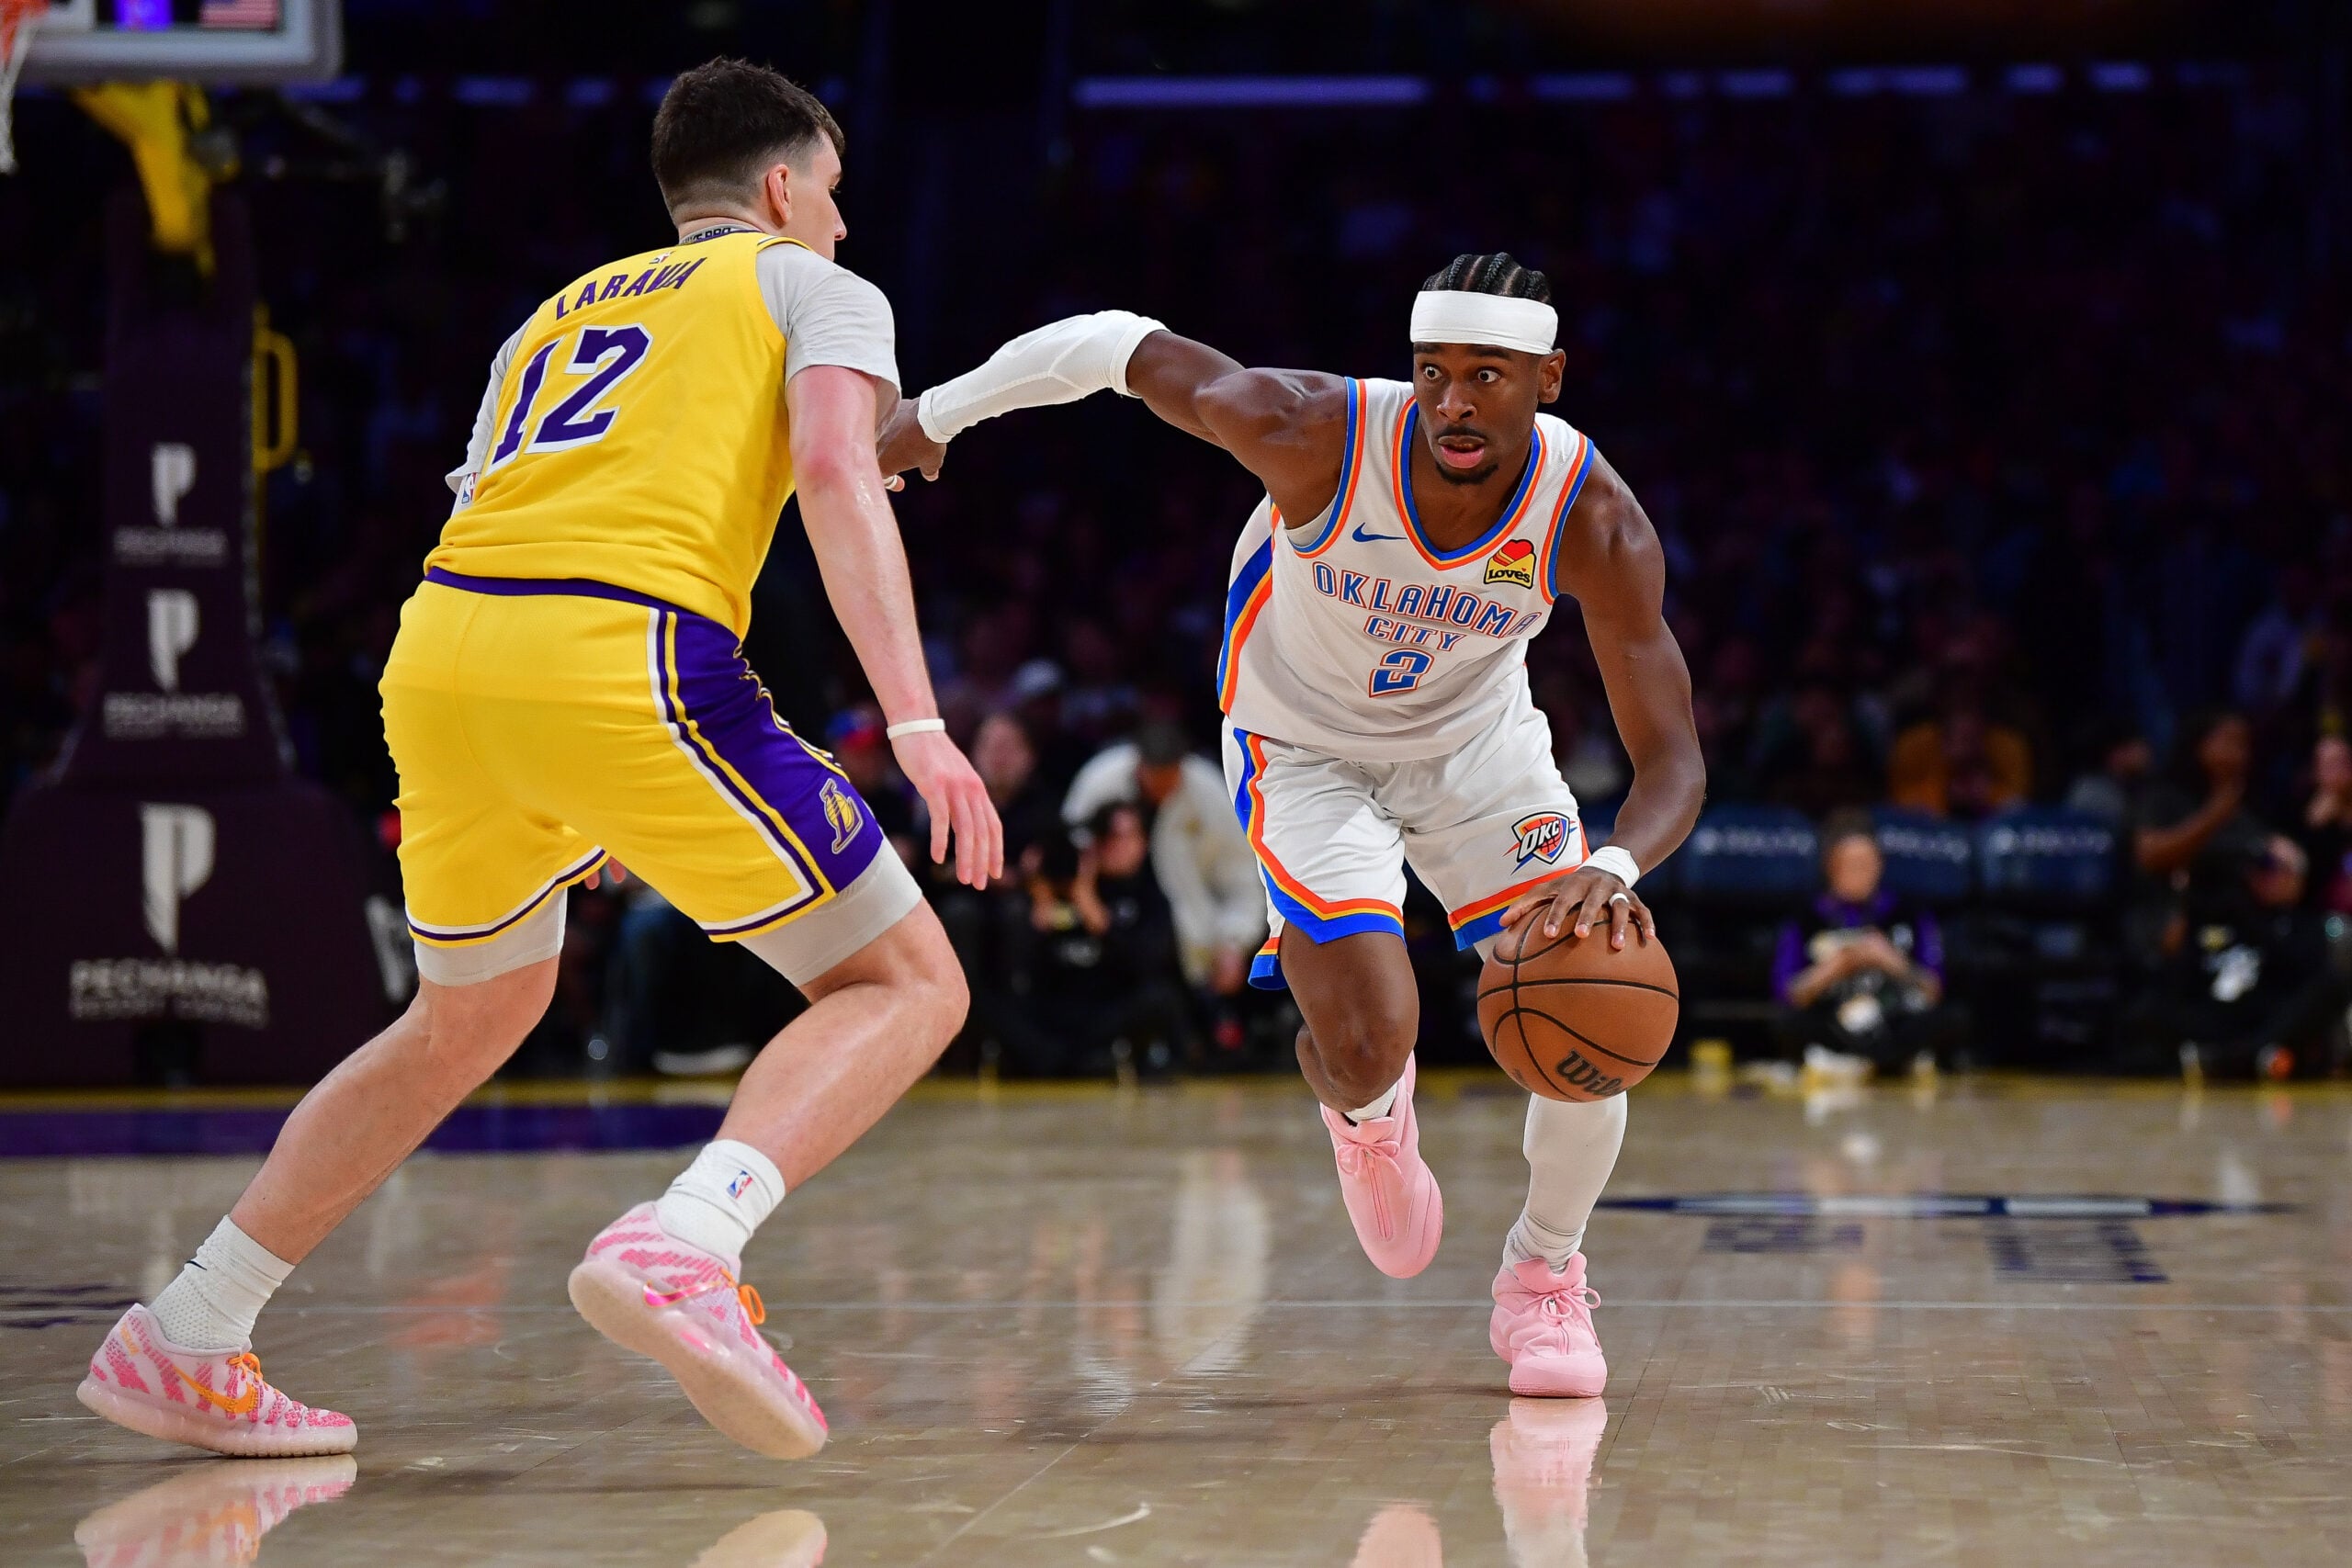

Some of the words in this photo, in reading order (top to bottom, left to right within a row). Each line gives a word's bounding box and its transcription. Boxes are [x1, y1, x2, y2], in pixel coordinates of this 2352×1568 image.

[555, 256, 707, 321] LARAVIA
[484, 322, 653, 478] 12
[1312, 561, 1542, 638] OKLAHOMA
[1363, 615, 1467, 651] CITY
[1368, 648, 1434, 698] 2
[1518, 819, 1560, 861] OKC
